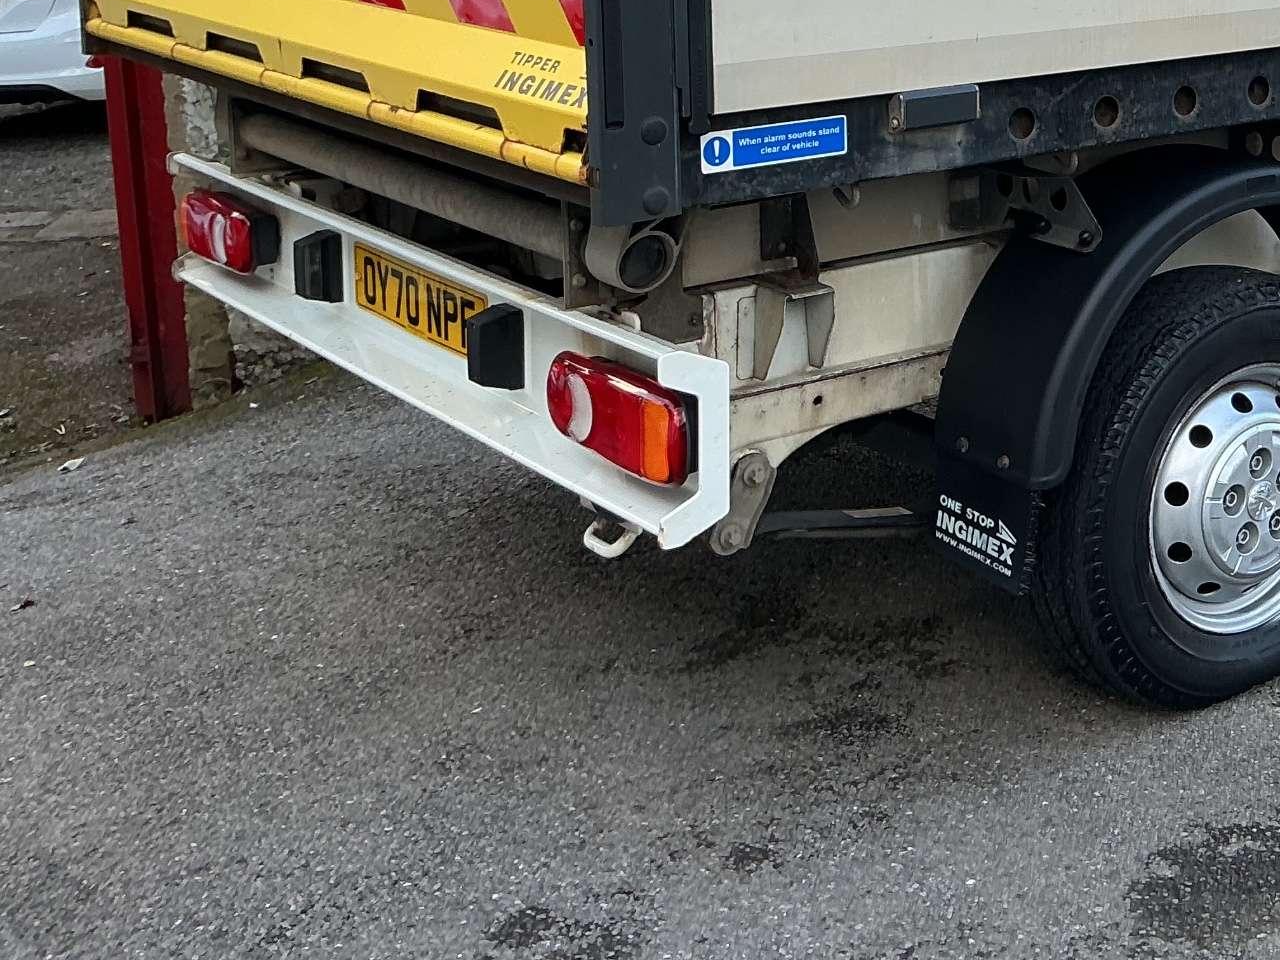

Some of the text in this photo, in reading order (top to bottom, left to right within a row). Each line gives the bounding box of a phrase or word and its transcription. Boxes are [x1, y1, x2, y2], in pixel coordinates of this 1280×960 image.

[510, 51, 561, 74] TIPPER
[494, 69, 587, 109] INGIMEX
[738, 126, 840, 147] When alarm sounds stand
[760, 140, 820, 155] clear of vehicle
[363, 255, 420, 327] OY70
[939, 494, 995, 529] ONE STOP
[936, 510, 1015, 566] INGIMEX
